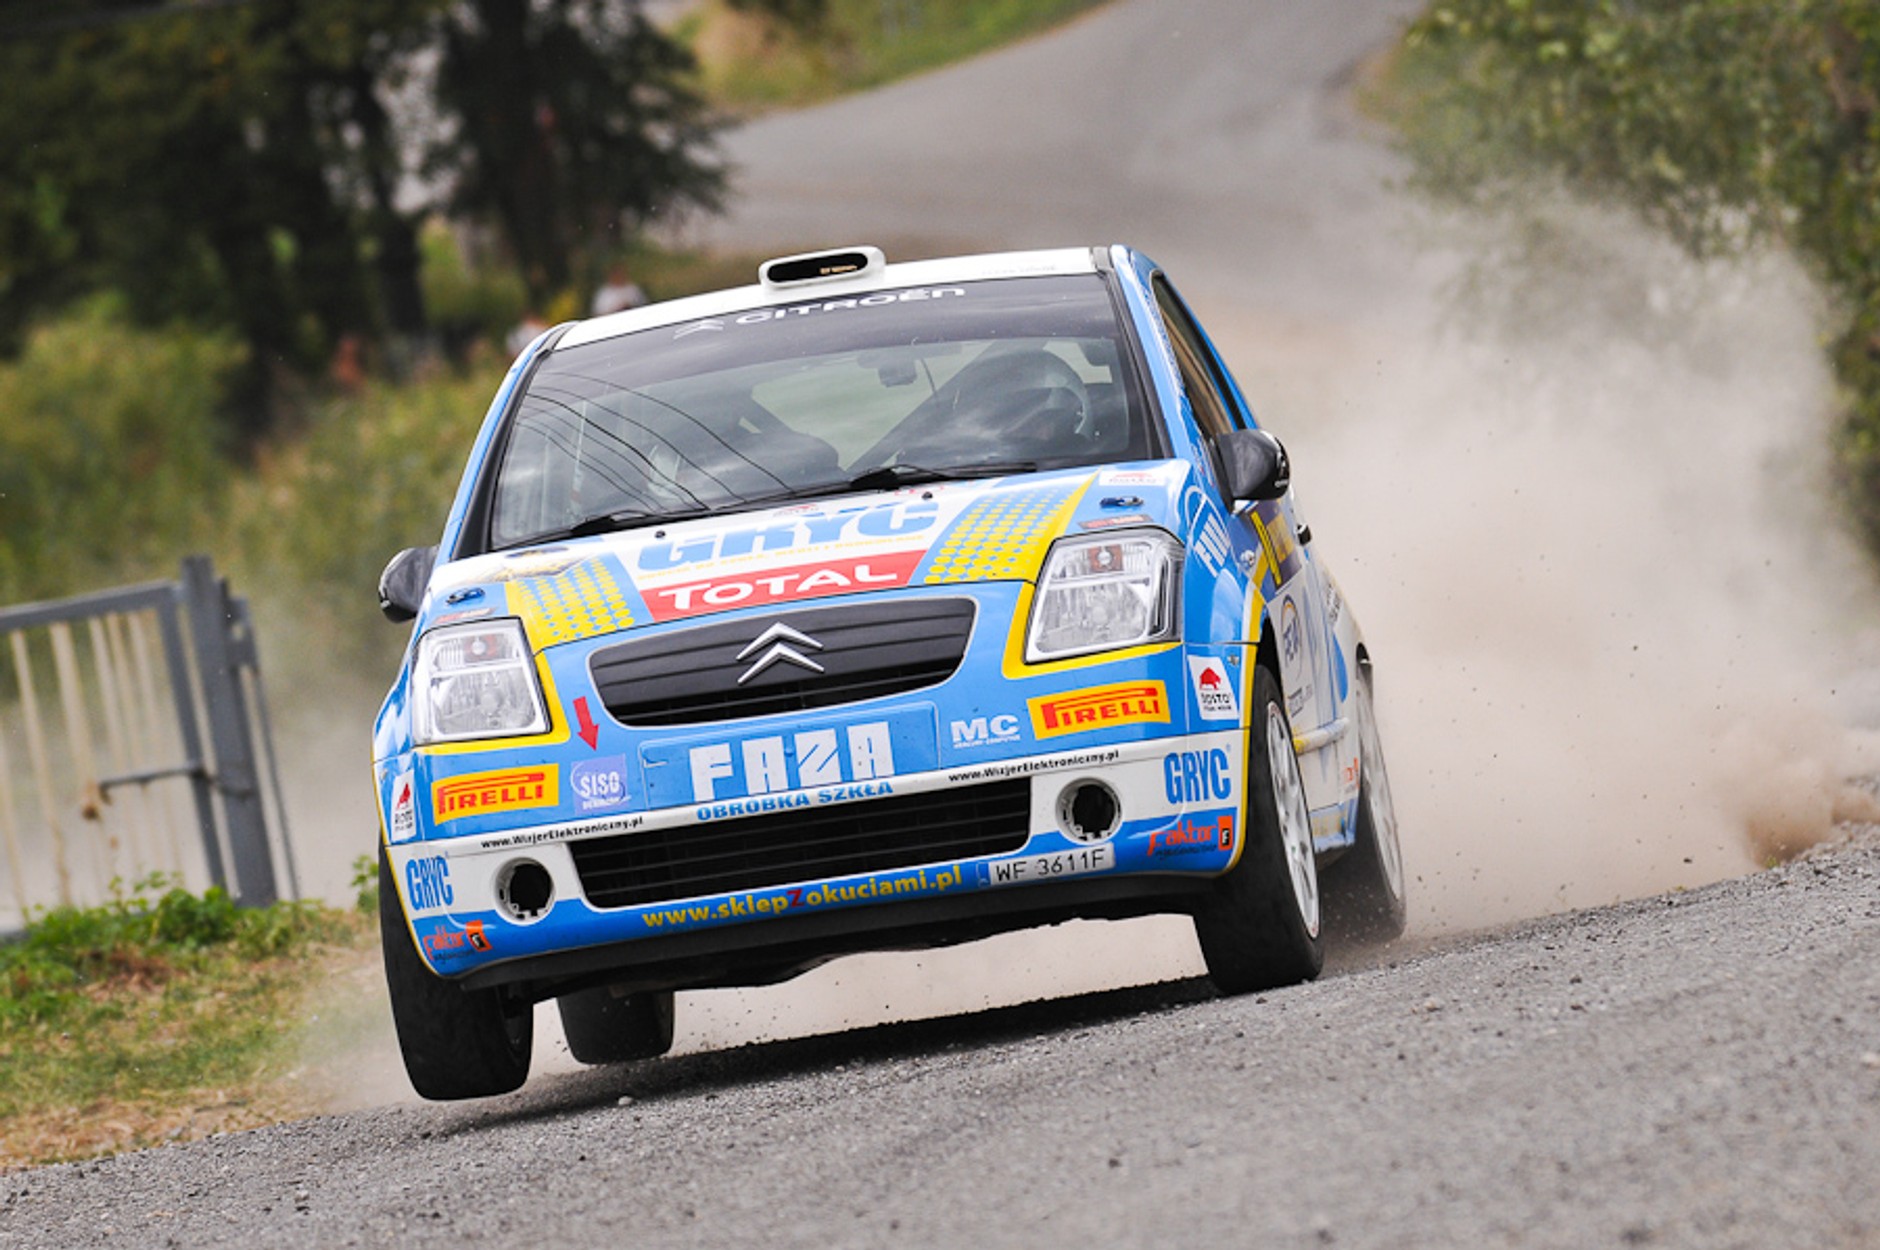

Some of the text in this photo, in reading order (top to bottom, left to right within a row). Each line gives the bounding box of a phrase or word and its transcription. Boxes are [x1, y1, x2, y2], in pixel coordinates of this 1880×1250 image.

[659, 564, 898, 610] TOTAL
[950, 714, 1020, 742] MC
[1040, 687, 1160, 730] PIRELLI
[689, 722, 895, 800] FAZA
[1163, 747, 1231, 804] GRYC
[437, 772, 547, 815] PIRELLI
[580, 771, 621, 798] SISO
[406, 855, 455, 912] GRYC
[996, 848, 1105, 882] WF 3611F
[642, 866, 963, 928] www.sklepZokuciami.pl
